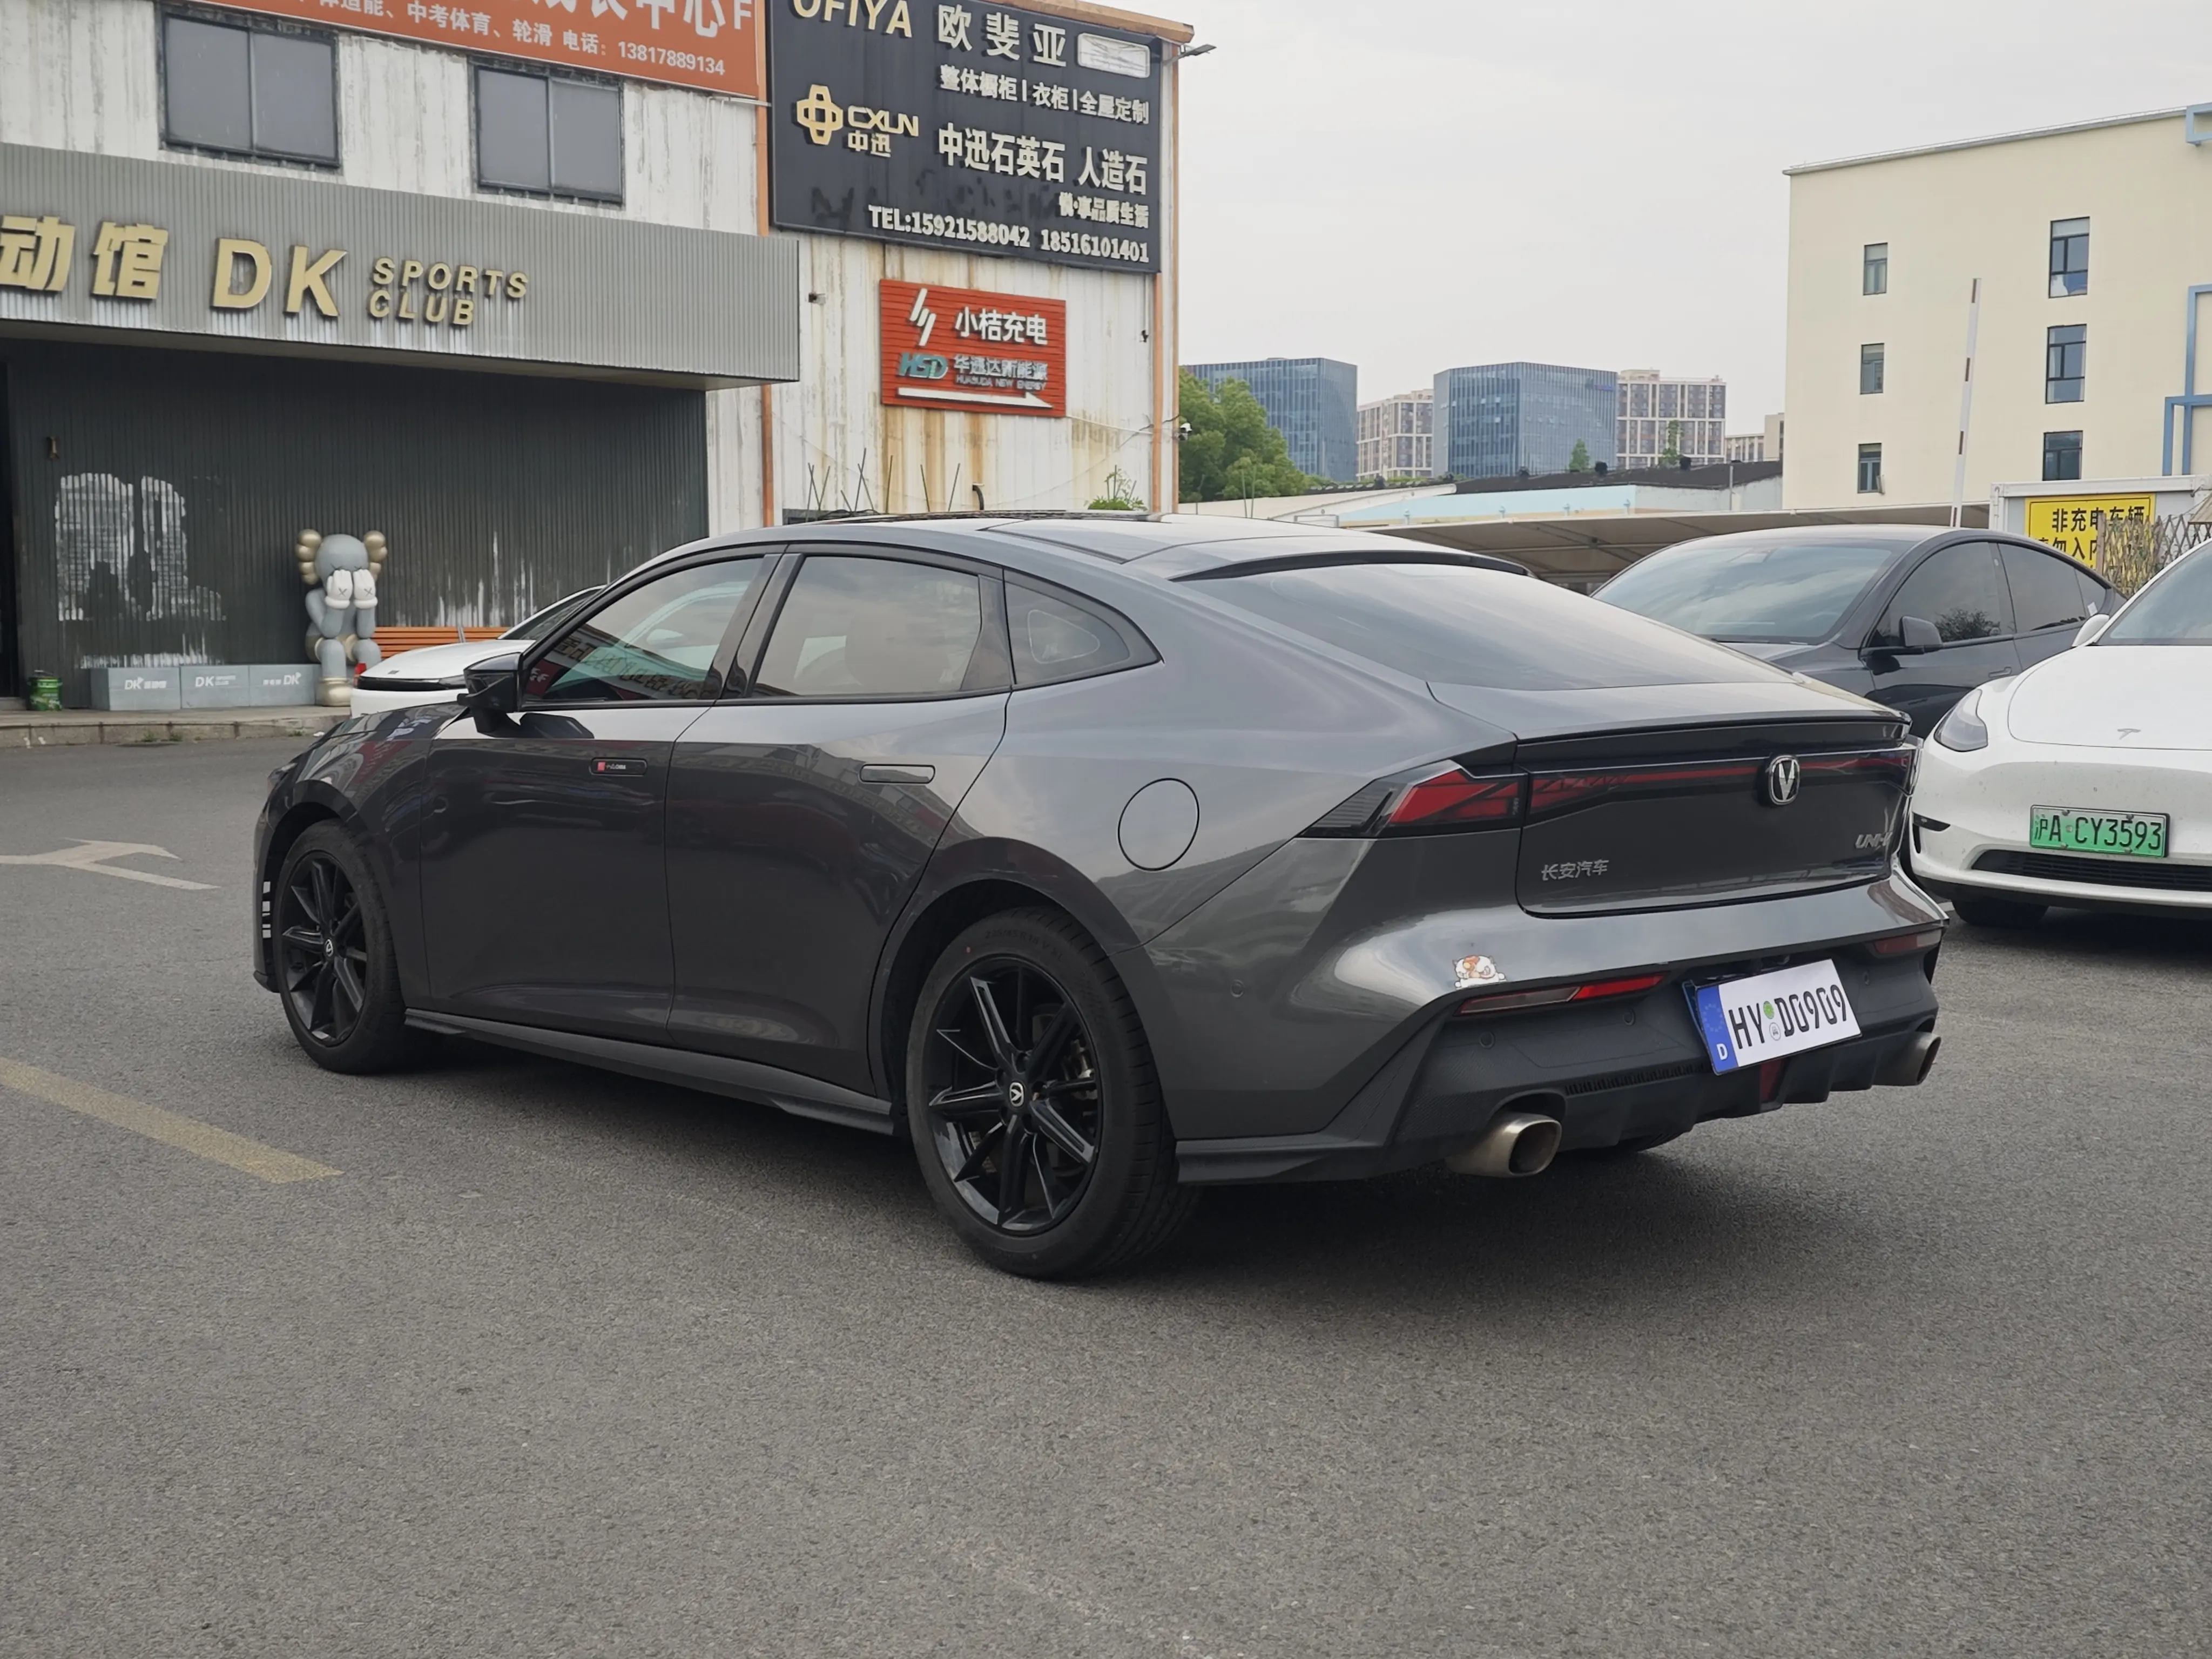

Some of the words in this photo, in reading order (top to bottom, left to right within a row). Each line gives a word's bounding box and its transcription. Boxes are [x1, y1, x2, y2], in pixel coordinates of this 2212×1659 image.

[939, 4, 1067, 66] 欧斐亚
[618, 41, 725, 75] 13817889134
[848, 130, 891, 157] 中迅
[1079, 146, 1148, 195] 人造石
[1041, 229, 1149, 263] 18516101401
[213, 237, 347, 317] DK
[373, 257, 529, 299] SPORTS
[369, 290, 474, 325] CLUB
[955, 306, 1048, 345] 小桔充电
[1541, 859, 1609, 880] 长安汽车
[1729, 1003, 1765, 1049] HY
